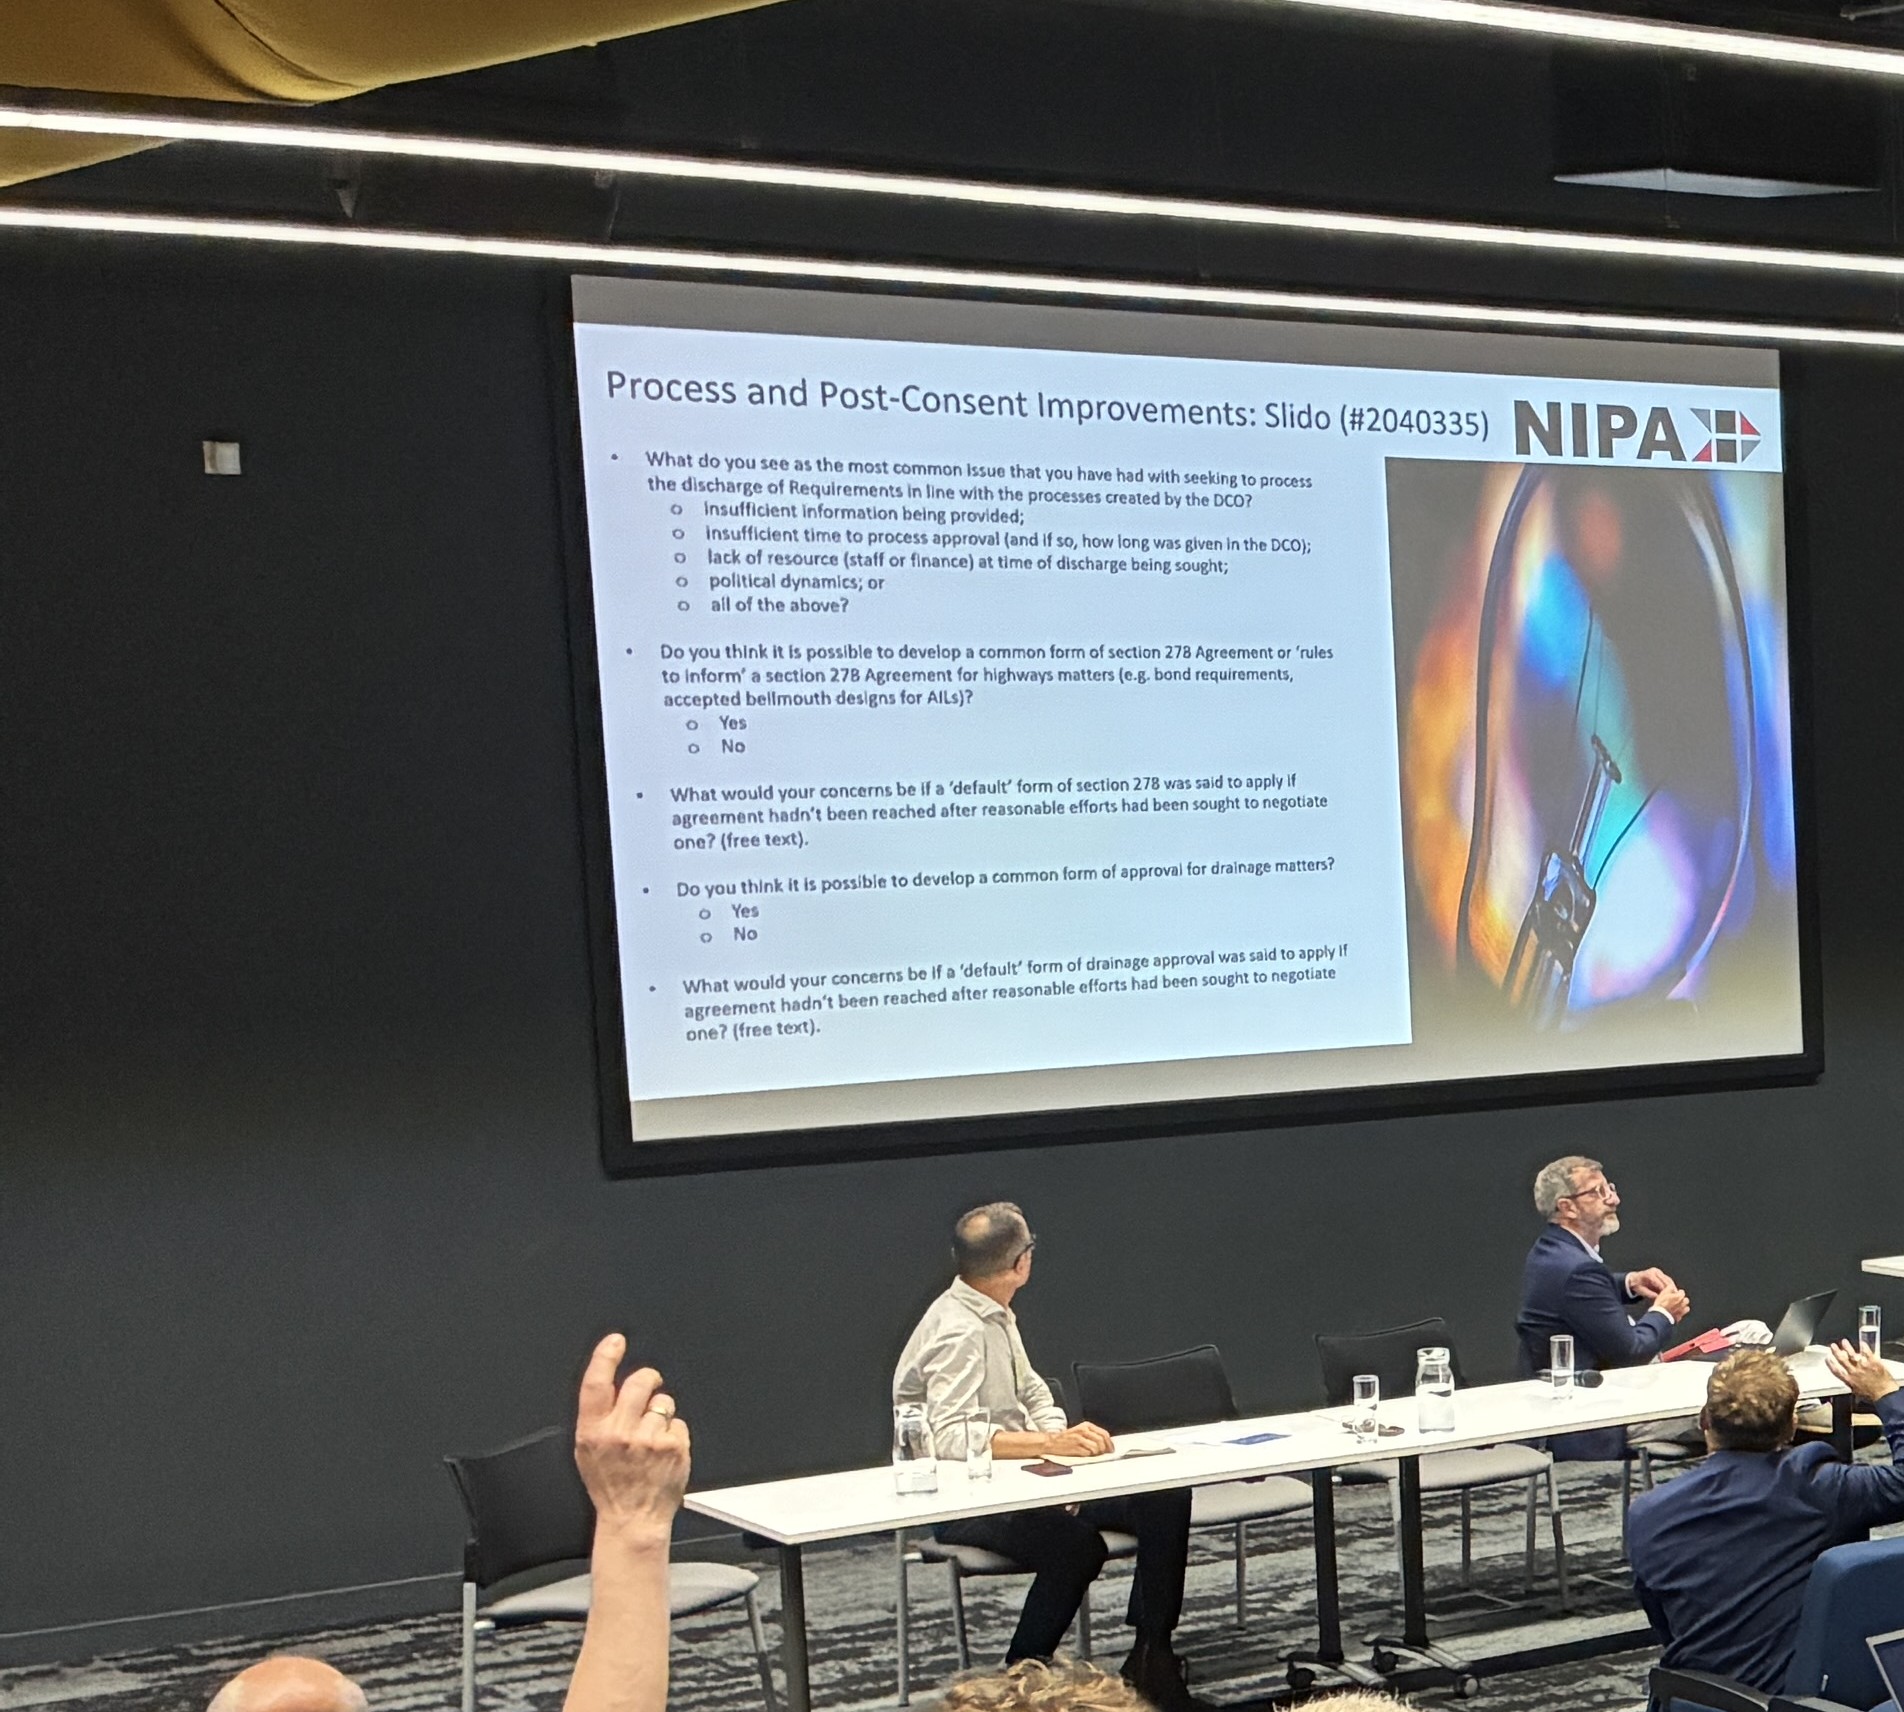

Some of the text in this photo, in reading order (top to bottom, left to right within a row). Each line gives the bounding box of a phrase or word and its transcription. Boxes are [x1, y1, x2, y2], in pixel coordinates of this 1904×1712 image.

[607, 370, 1488, 442] Process and Post-Consent Improvements: Slido (#2040335)
[1514, 400, 1687, 461] NIPA
[645, 451, 1312, 489] What do you see as the most common issue that you have had with seeking to process
[647, 477, 1253, 509] the discharge of Requirements in line with the processes created by the DCO?
[704, 501, 1024, 526] insufficient information being provided;
[706, 526, 799, 542] insufficient
[803, 527, 841, 543] time
[845, 529, 863, 543] to
[867, 531, 928, 546] process
[932, 531, 1000, 548] approval
[1004, 531, 1039, 549] (and
[1042, 532, 1052, 547] if
[1082, 533, 1114, 548] how
[1117, 534, 1150, 552] long
[1152, 538, 1181, 550] was
[1184, 536, 1223, 553] given
[1226, 536, 1240, 551] in
[1242, 537, 1267, 551] the
[707, 550, 1228, 576] lack of resource (staff or finance) at time of discharge being sought;
[709, 573, 885, 592] political dynamics; or
[711, 596, 849, 613] all of the above?
[660, 643, 684, 659] Do
[688, 647, 720, 662] you
[724, 643, 768, 659] think
[772, 644, 784, 659] it
[788, 644, 802, 659] is
[806, 643, 873, 662] possible
[876, 645, 894, 659] to
[898, 643, 961, 662] develop
[966, 647, 974, 659] a
[978, 647, 1046, 659] common
[1049, 644, 1085, 659] form
[1089, 644, 1104, 659] of
[1108, 645, 1161, 659] section
[1164, 644, 1192, 659] 278
[1195, 645, 1273, 662] Agreement
[1277, 648, 1292, 659] or
[661, 670, 680, 684] to
[751, 671, 761, 683] a
[766, 668, 826, 683] section
[830, 668, 860, 683] 278
[864, 668, 952, 686] Agreement
[956, 668, 979, 682] for
[983, 668, 1054, 685] highways
[1057, 668, 1115, 682] matters
[1154, 668, 1191, 681] bond
[1195, 668, 1293, 684] requirements,
[664, 691, 741, 710] accepted
[745, 690, 831, 706] bellmouth
[834, 690, 896, 708] designs
[900, 690, 923, 705] for
[718, 714, 747, 730] Yes
[721, 738, 746, 754] No
[730, 902, 759, 919] Yes
[733, 926, 758, 941] No
[682, 978, 729, 994] What
[733, 974, 786, 991] would
[789, 975, 827, 992] your
[831, 970, 903, 985] concerns
[907, 968, 927, 981] be
[932, 966, 942, 980] if
[946, 967, 955, 979] a
[1027, 961, 1063, 974] form
[1066, 959, 1082, 972] of
[1086, 957, 1149, 972] drainage
[1152, 951, 1214, 970] approval
[1218, 951, 1246, 963] was
[1248, 947, 1277, 962] said
[1280, 948, 1295, 960] to
[1298, 944, 1335, 962] apply
[1338, 943, 1348, 957] if
[684, 967, 1336, 1021] agreement hadn't been reached after reasonable efforts had been sought to negotiate
[686, 1021, 821, 1041] one? (free text).
